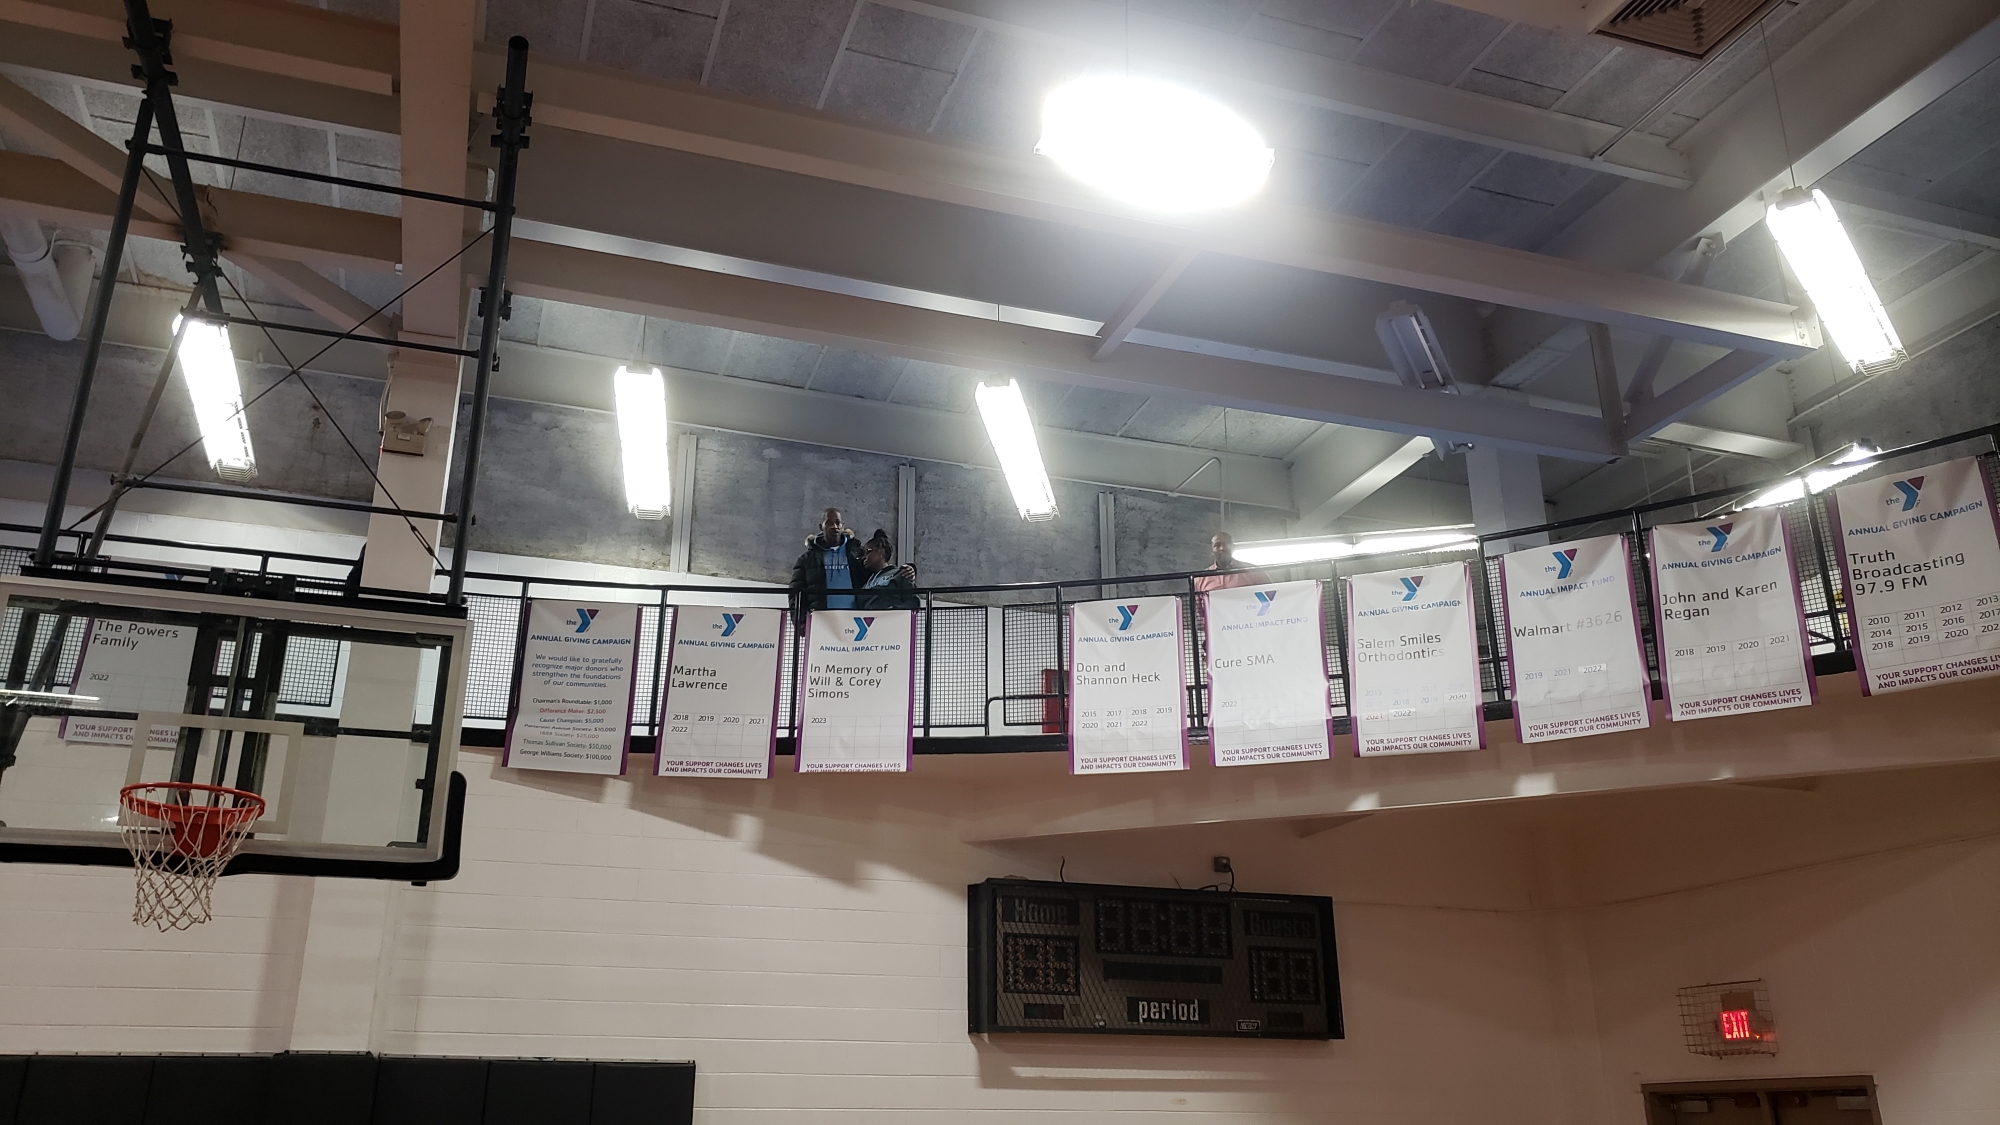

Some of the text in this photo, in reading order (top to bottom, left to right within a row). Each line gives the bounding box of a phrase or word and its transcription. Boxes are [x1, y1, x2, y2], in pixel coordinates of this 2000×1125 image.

[1886, 497, 1900, 506] the
[1848, 524, 1891, 536] ANNUAL
[1892, 515, 1927, 529] GIVING
[1929, 500, 1983, 521] CAMPAIGN
[1698, 539, 1711, 547] the
[1661, 561, 1699, 570] ANNUAL
[1701, 557, 1733, 568] GIVING
[1735, 546, 1781, 562] CAMPAIGN
[1849, 550, 1895, 565] Truth
[1545, 565, 1556, 573] the
[1852, 552, 1965, 580] Broadcasting
[1519, 575, 1615, 598] ANNUAL IMPACT FUND
[1855, 575, 1927, 596] 97.9 FM
[1662, 581, 1778, 606] John and Karen
[1664, 607, 1710, 621] Regan
[1867, 595, 1999, 625] 2010 2011 2012 2013
[98, 620, 179, 638] The Powers
[1513, 610, 1623, 638] Walmart #3626
[1870, 609, 2000, 638] 2014 2015 2016 2017
[93, 634, 139, 650] Family
[565, 636, 590, 644] GIVING
[1136, 631, 1174, 641] CAMPAIGN
[1357, 633, 1441, 649] Salem Smiles
[1871, 624, 1999, 650] 2018 2019 2020 202
[1674, 635, 1790, 657] 2018 2019 2020 2021
[1214, 654, 1275, 669] Cure SMA
[1358, 647, 1444, 662] Orthodontics
[532, 662, 563, 670] recognize
[673, 665, 717, 677] Martha
[810, 663, 889, 676] In Memory of
[1076, 662, 1126, 672] Don and
[1525, 665, 1602, 680] 2019 2021 2022
[90, 673, 109, 681] 2022
[671, 678, 728, 690] Lawrence
[809, 676, 881, 688] Will & Corey
[1076, 672, 1160, 685] Shannon Heck
[808, 688, 850, 698] Simons
[1013, 901, 1068, 923] Home
[1138, 998, 1199, 1023] period
[1722, 1011, 1750, 1039] EXIT
